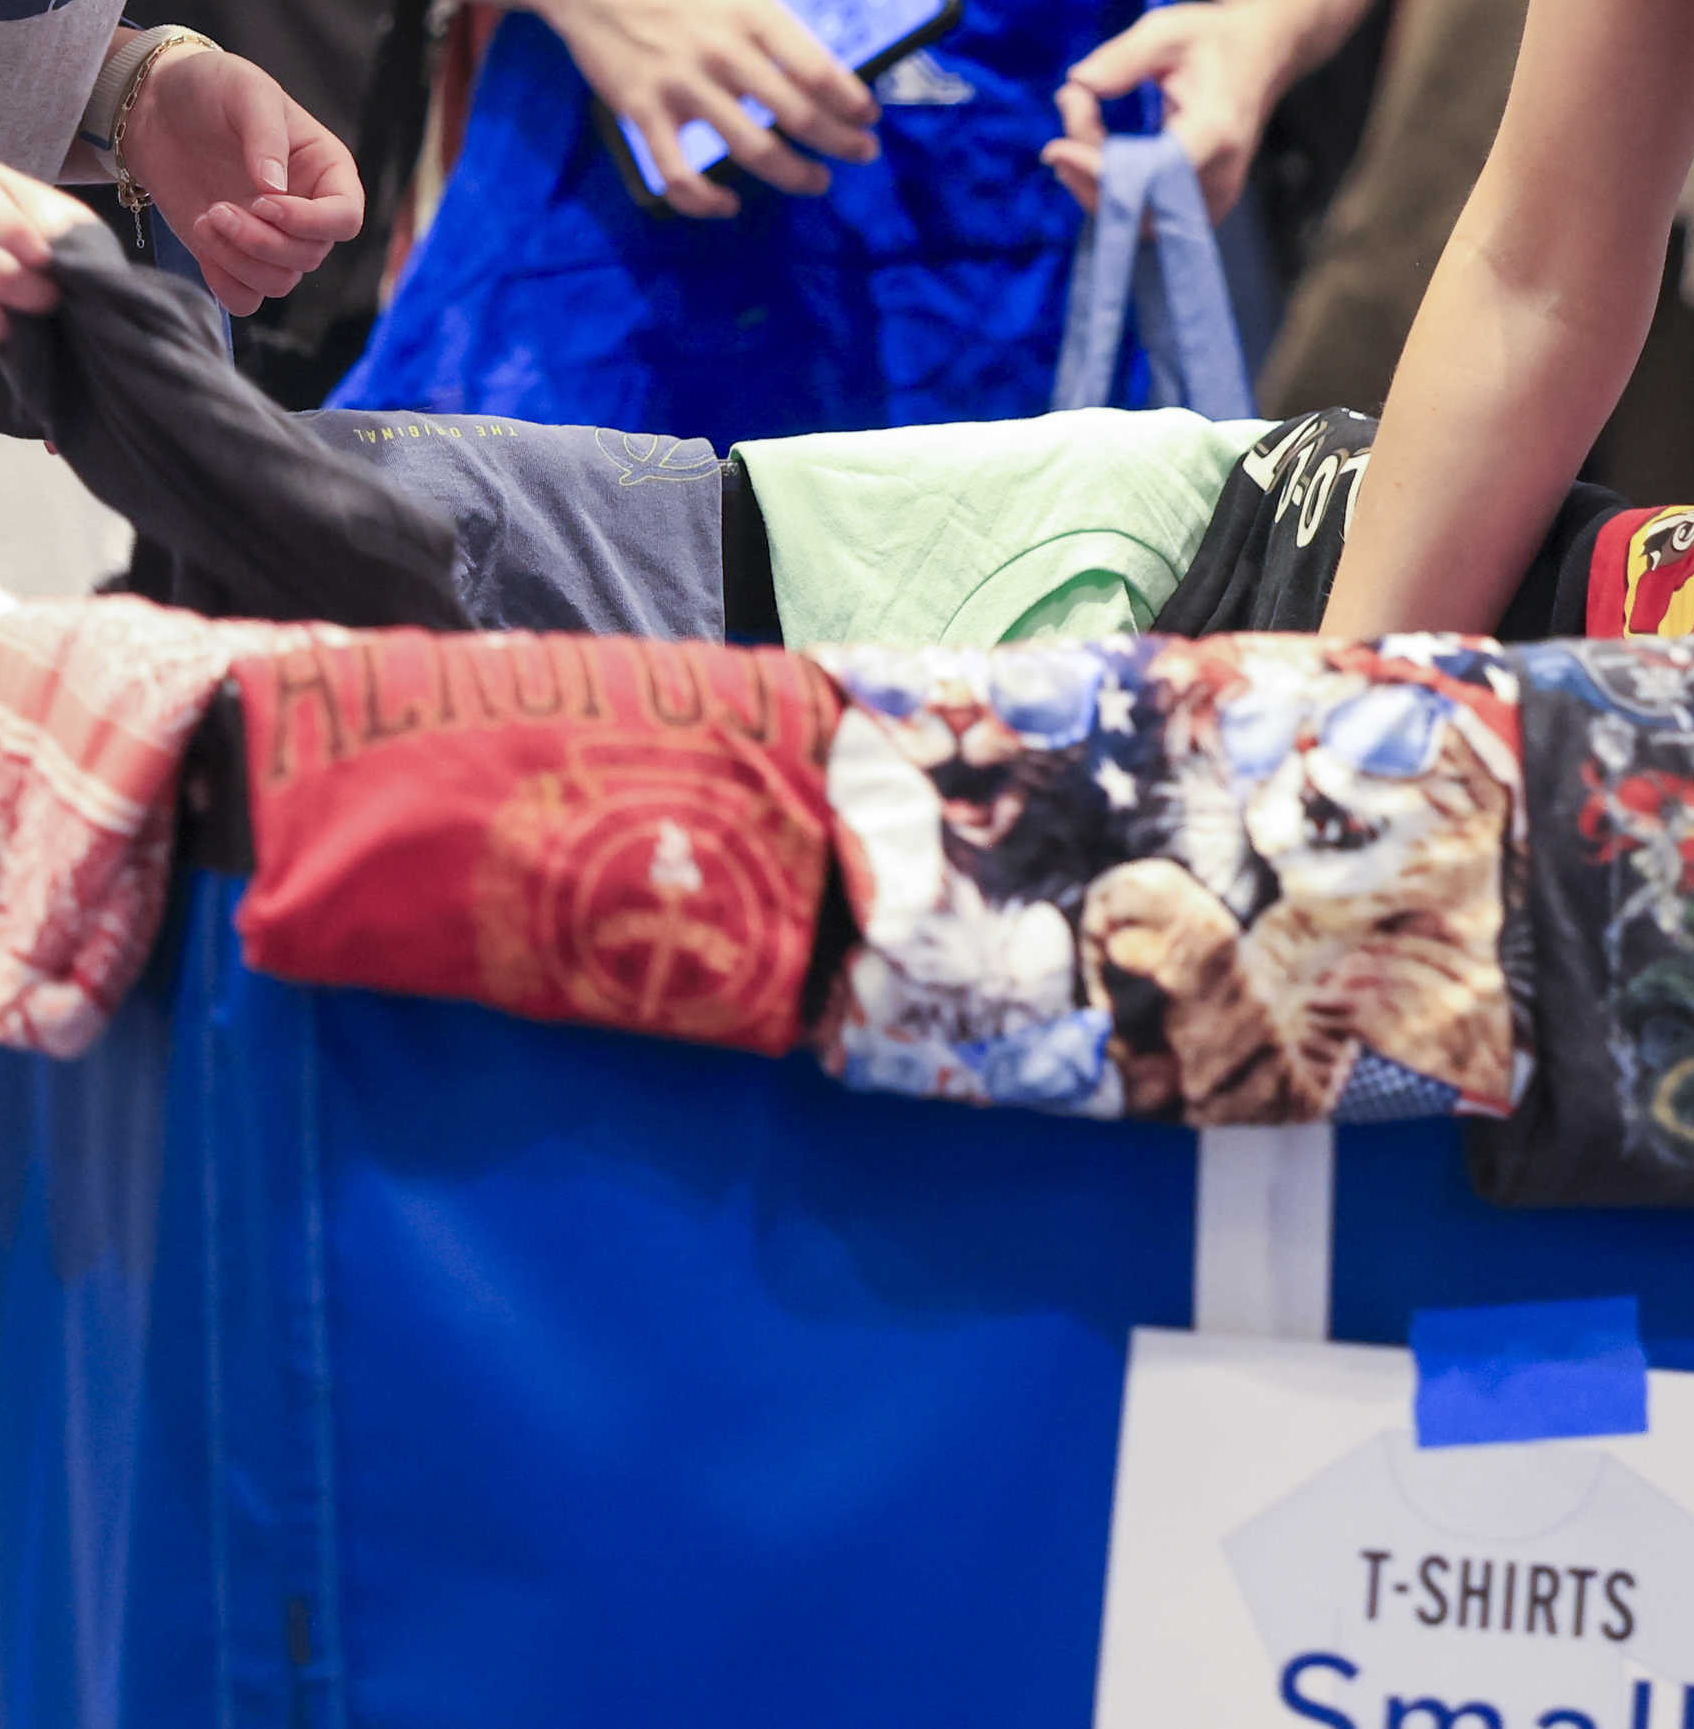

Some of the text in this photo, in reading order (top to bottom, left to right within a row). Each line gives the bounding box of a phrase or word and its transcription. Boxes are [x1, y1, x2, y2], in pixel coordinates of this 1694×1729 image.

[353, 423, 518, 444] THE ORIGINAL
[1359, 1548, 1636, 1642] T-SHIRTS
